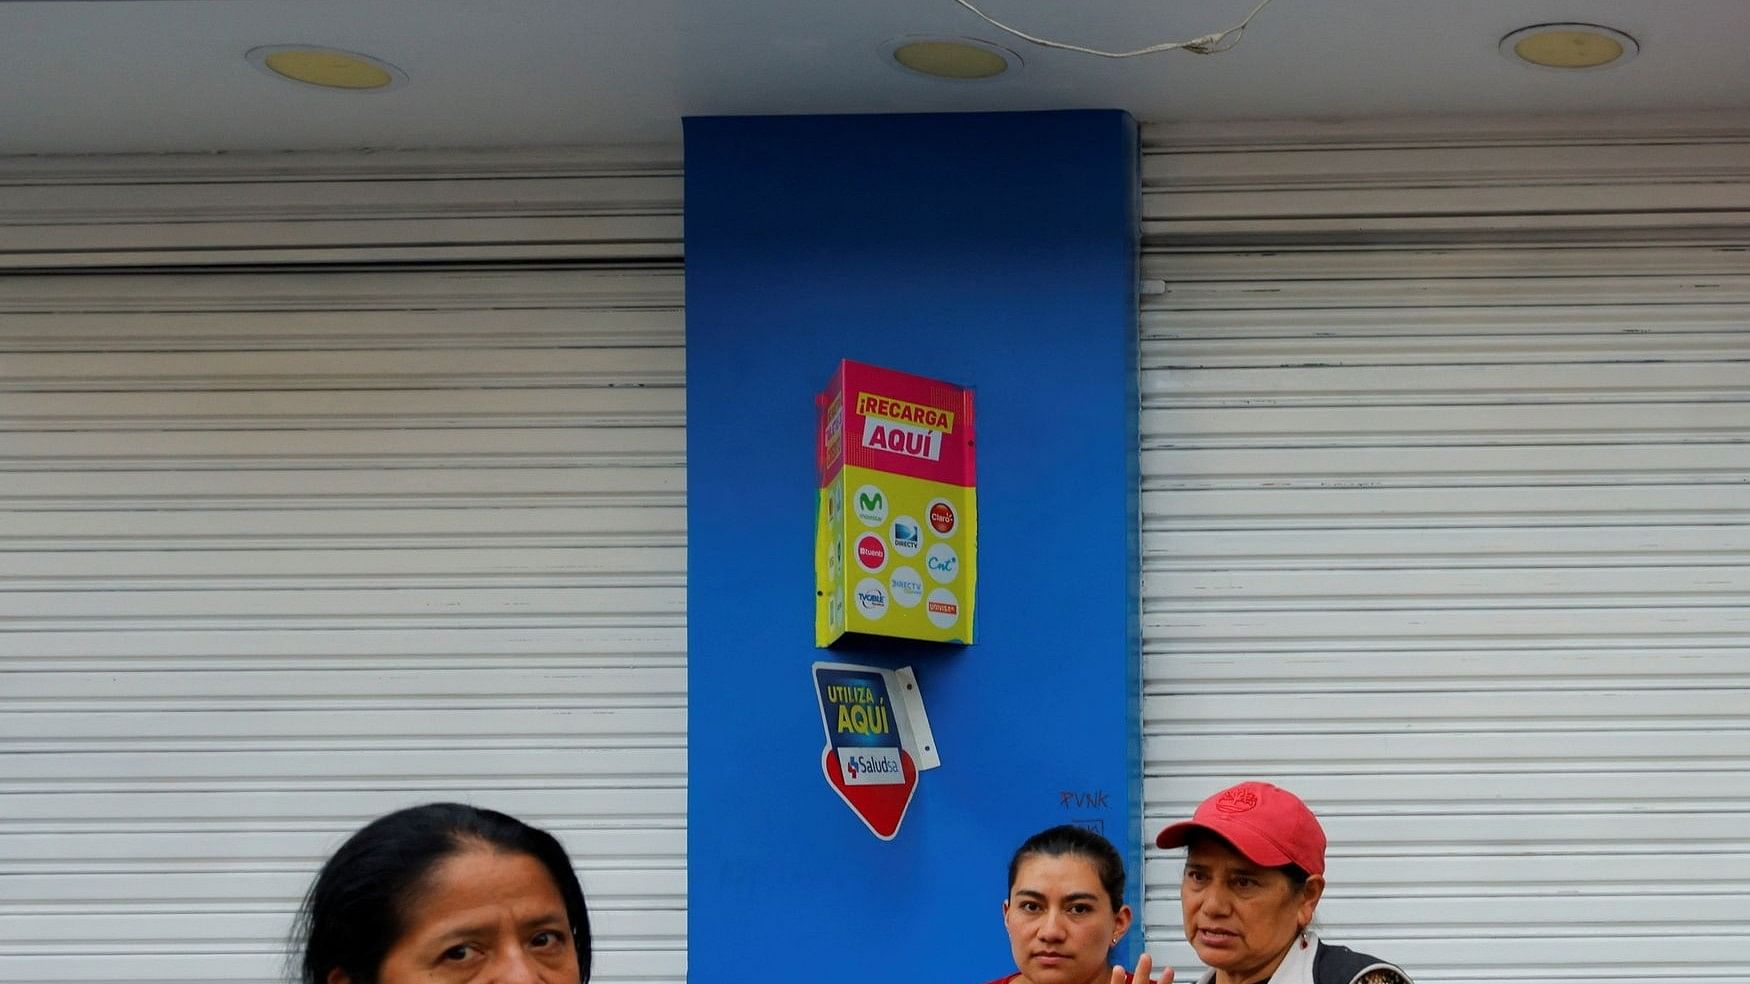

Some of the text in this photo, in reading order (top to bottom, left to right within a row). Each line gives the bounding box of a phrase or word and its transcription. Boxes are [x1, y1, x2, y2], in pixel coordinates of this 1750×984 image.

[860, 397, 948, 429] ¡RECARGA
[869, 425, 933, 457] AQUÍ
[827, 685, 874, 704] UTILIZA
[837, 697, 890, 736] AQUÍ
[859, 756, 899, 774] Saludsa
